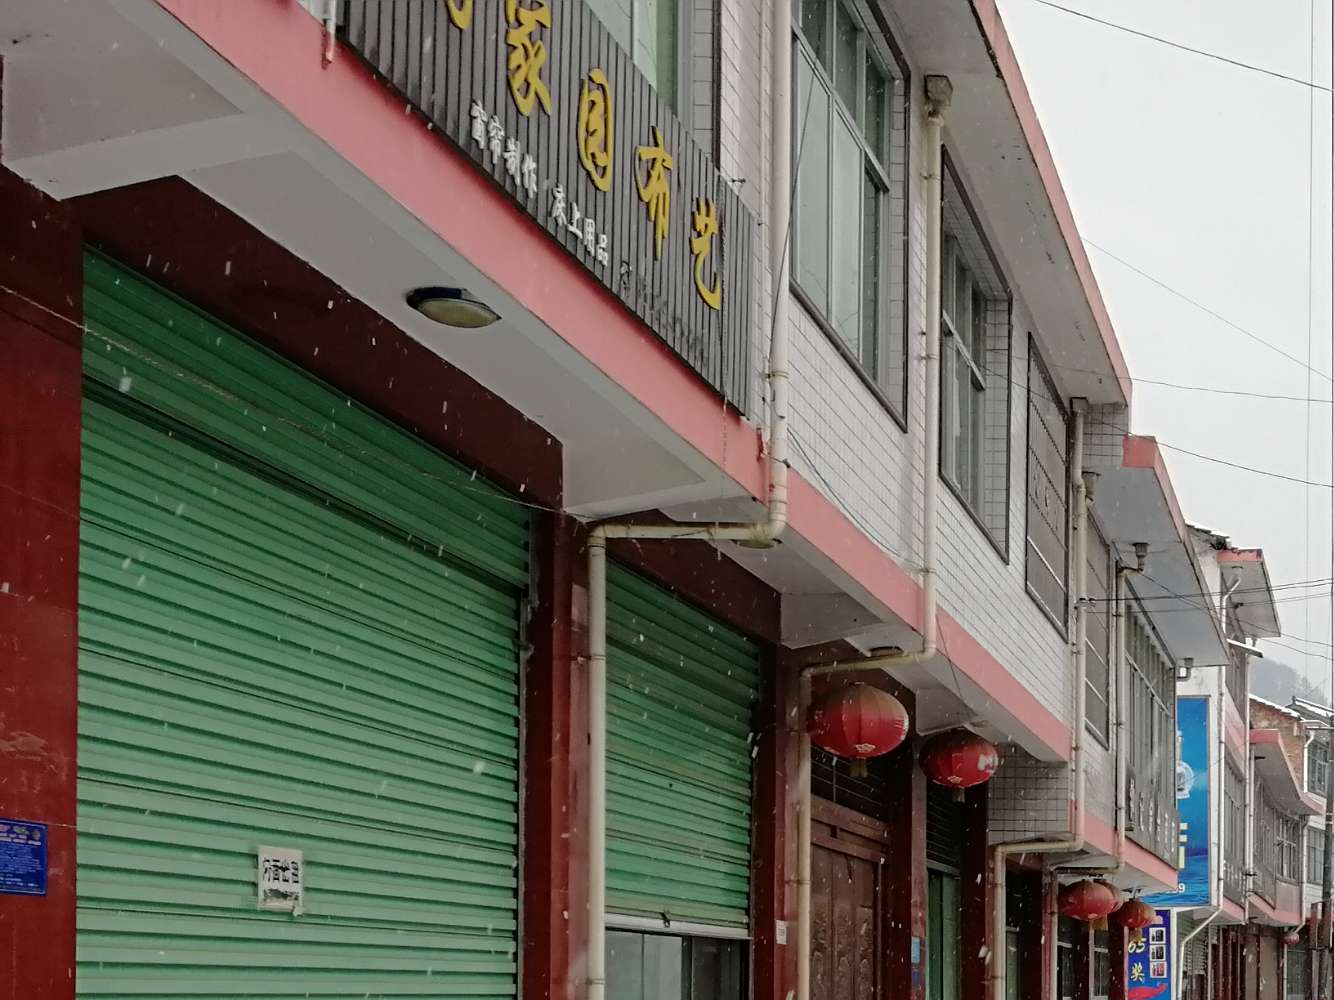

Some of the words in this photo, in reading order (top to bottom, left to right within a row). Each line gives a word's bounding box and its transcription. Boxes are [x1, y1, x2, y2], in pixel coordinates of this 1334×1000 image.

[445, 0, 723, 312] 家园布艺
[551, 183, 609, 267] 床上用品
